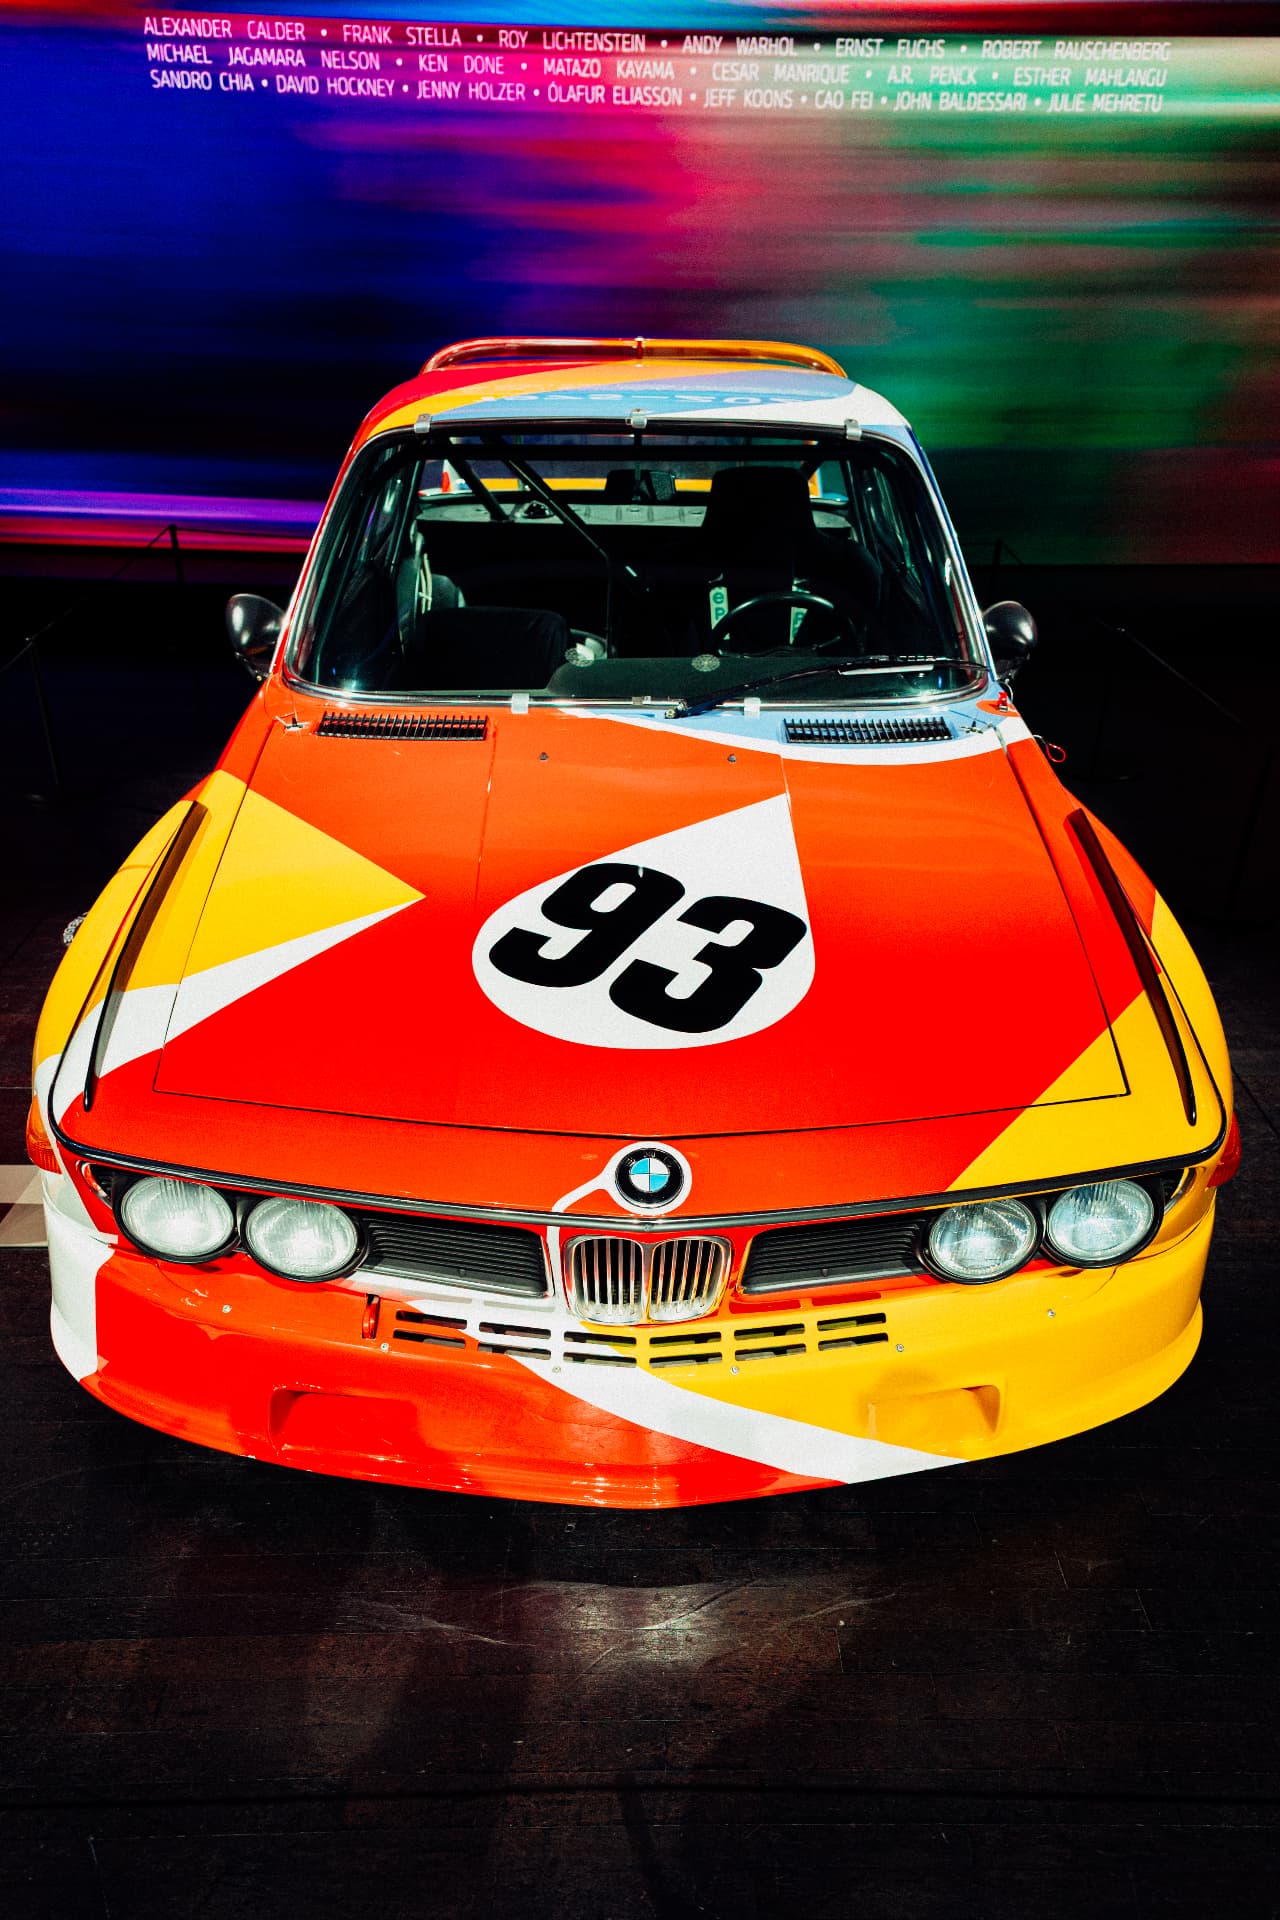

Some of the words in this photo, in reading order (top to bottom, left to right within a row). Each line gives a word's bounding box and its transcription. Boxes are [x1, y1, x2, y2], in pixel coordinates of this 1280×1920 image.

[144, 17, 233, 39] ALEXANDER
[247, 20, 306, 41] CALDER
[342, 24, 393, 45] FRANK
[406, 27, 462, 47] STELLA
[498, 30, 529, 48] ROY
[542, 31, 646, 53] LICHTENSTEIN
[682, 35, 723, 54] ANDY
[736, 36, 798, 56] WARHOL
[835, 38, 884, 58] ERNST
[896, 39, 946, 59] FUCHS
[981, 40, 1042, 60] ROBERT
[1054, 41, 1172, 61] RAUSCHENBERG
[147, 43, 213, 65] MICHAEL
[227, 46, 307, 67] JAGAMARA
[321, 50, 381, 70] NELSON
[418, 54, 449, 73] KEN
[464, 55, 505, 75] DONE
[543, 57, 602, 79] MATAZO
[616, 60, 676, 80] KAYAMA
[712, 61, 760, 81] CESAR
[773, 63, 850, 85] MANRIQUE
[887, 65, 914, 84] A.R.
[929, 66, 978, 86] PENCK
[1013, 67, 1071, 87] ESTHER
[1084, 68, 1168, 88] MAHLANGU
[150, 69, 213, 91] SANDRO
[219, 72, 255, 92] CHIA
[276, 74, 320, 95] DAVID
[327, 77, 395, 97] HOCKNEY
[416, 80, 461, 100] JENNY
[468, 81, 526, 101] HOLZER
[547, 80, 606, 105] ÓLAFUR
[612, 85, 683, 107] ELIASSON
[703, 88, 737, 108] JEFF
[743, 89, 793, 109] KOONS
[814, 89, 845, 109] CAO
[851, 91, 874, 110] FEI
[893, 91, 932, 112] JOHN
[938, 92, 1028, 112] BALDESSARI
[1047, 93, 1087, 113] JULIE
[1092, 93, 1164, 113] MEHRETU
[488, 862, 808, 1034] 93
